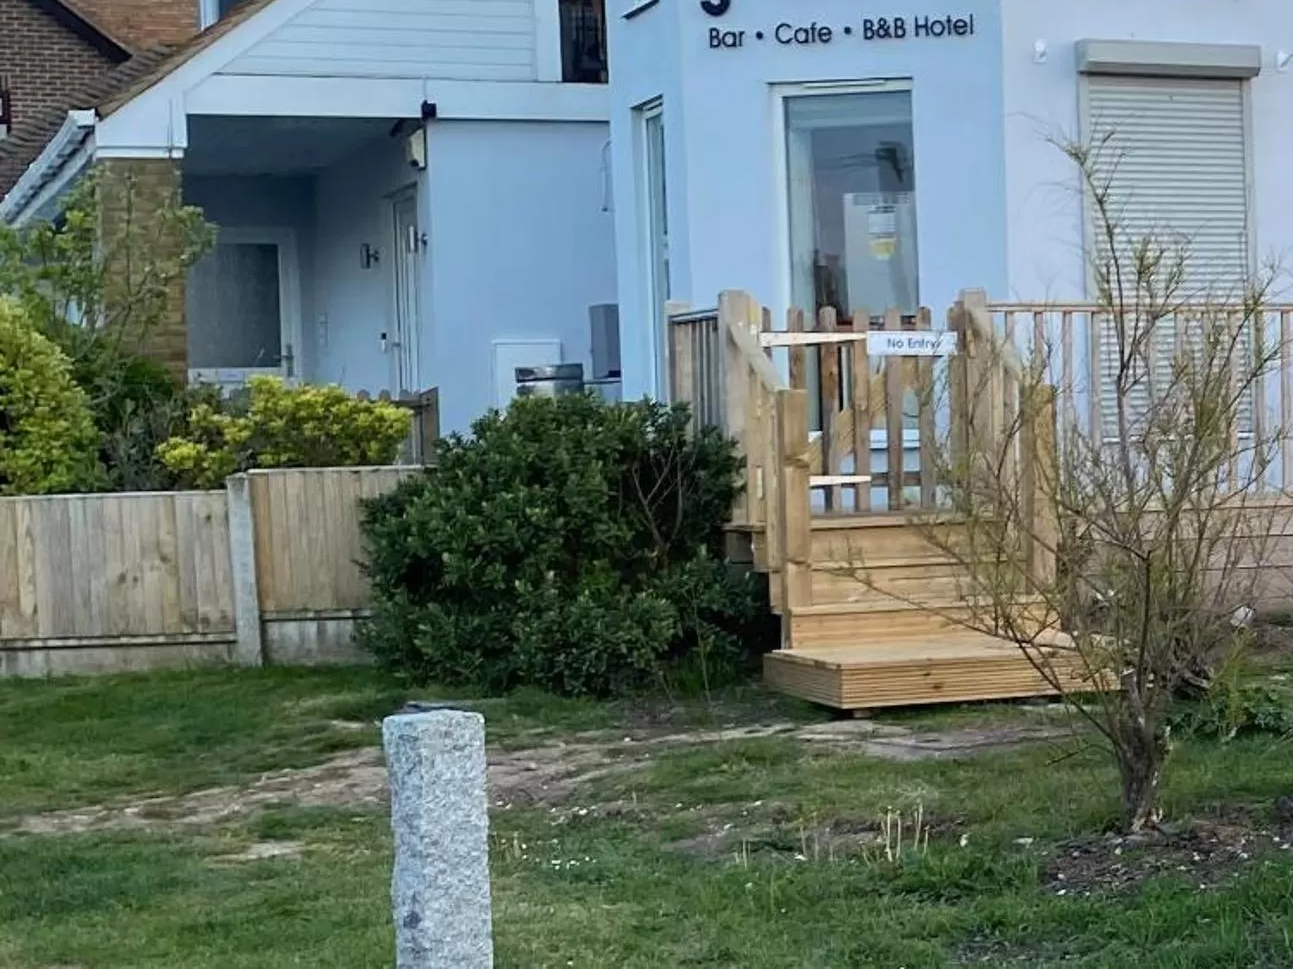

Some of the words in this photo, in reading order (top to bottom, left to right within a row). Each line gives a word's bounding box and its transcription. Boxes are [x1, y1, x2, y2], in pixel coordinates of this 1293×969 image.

[709, 27, 745, 48] Bar
[775, 22, 832, 45] Cafe
[863, 16, 906, 40] B&B
[914, 13, 974, 38] Hotel
[887, 338, 904, 349] No
[908, 337, 939, 352] Entry
